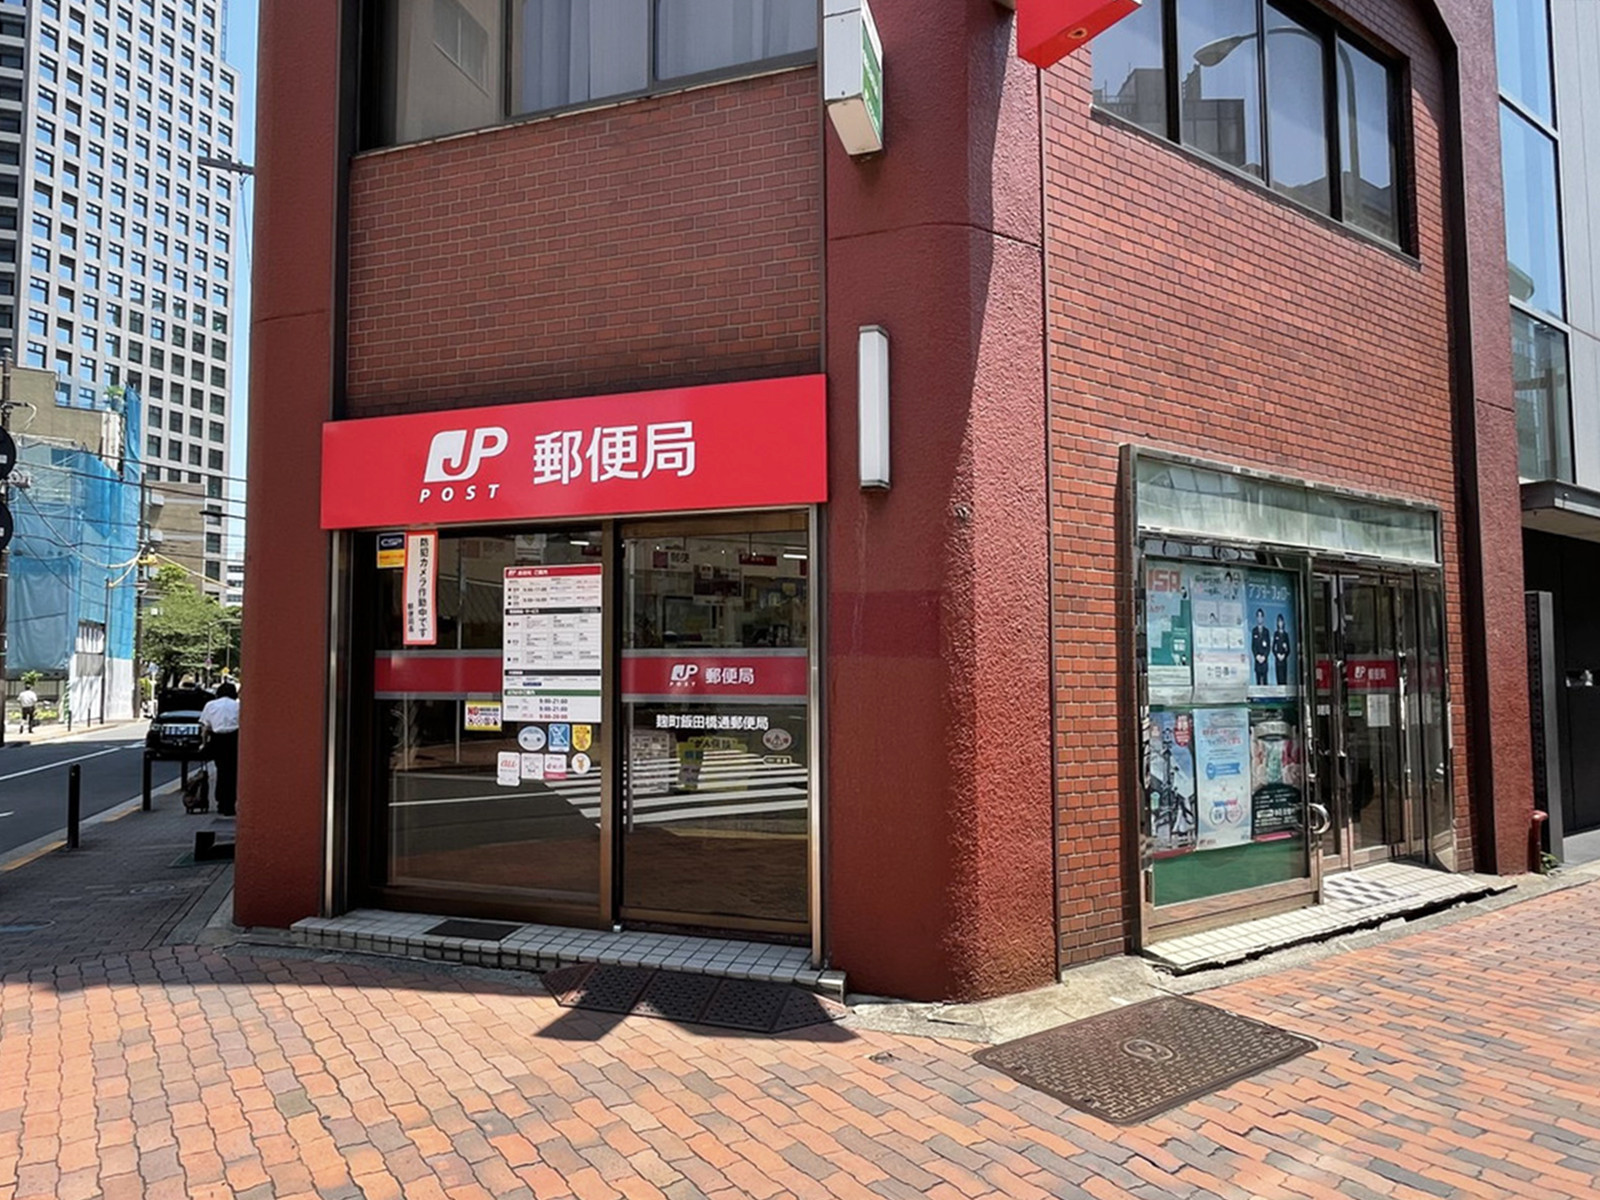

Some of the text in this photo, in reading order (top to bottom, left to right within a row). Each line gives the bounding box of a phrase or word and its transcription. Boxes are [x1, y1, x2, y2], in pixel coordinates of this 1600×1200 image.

[533, 421, 696, 485] 郵便局
[419, 484, 500, 503] POST
[705, 667, 754, 684] 郵便局
